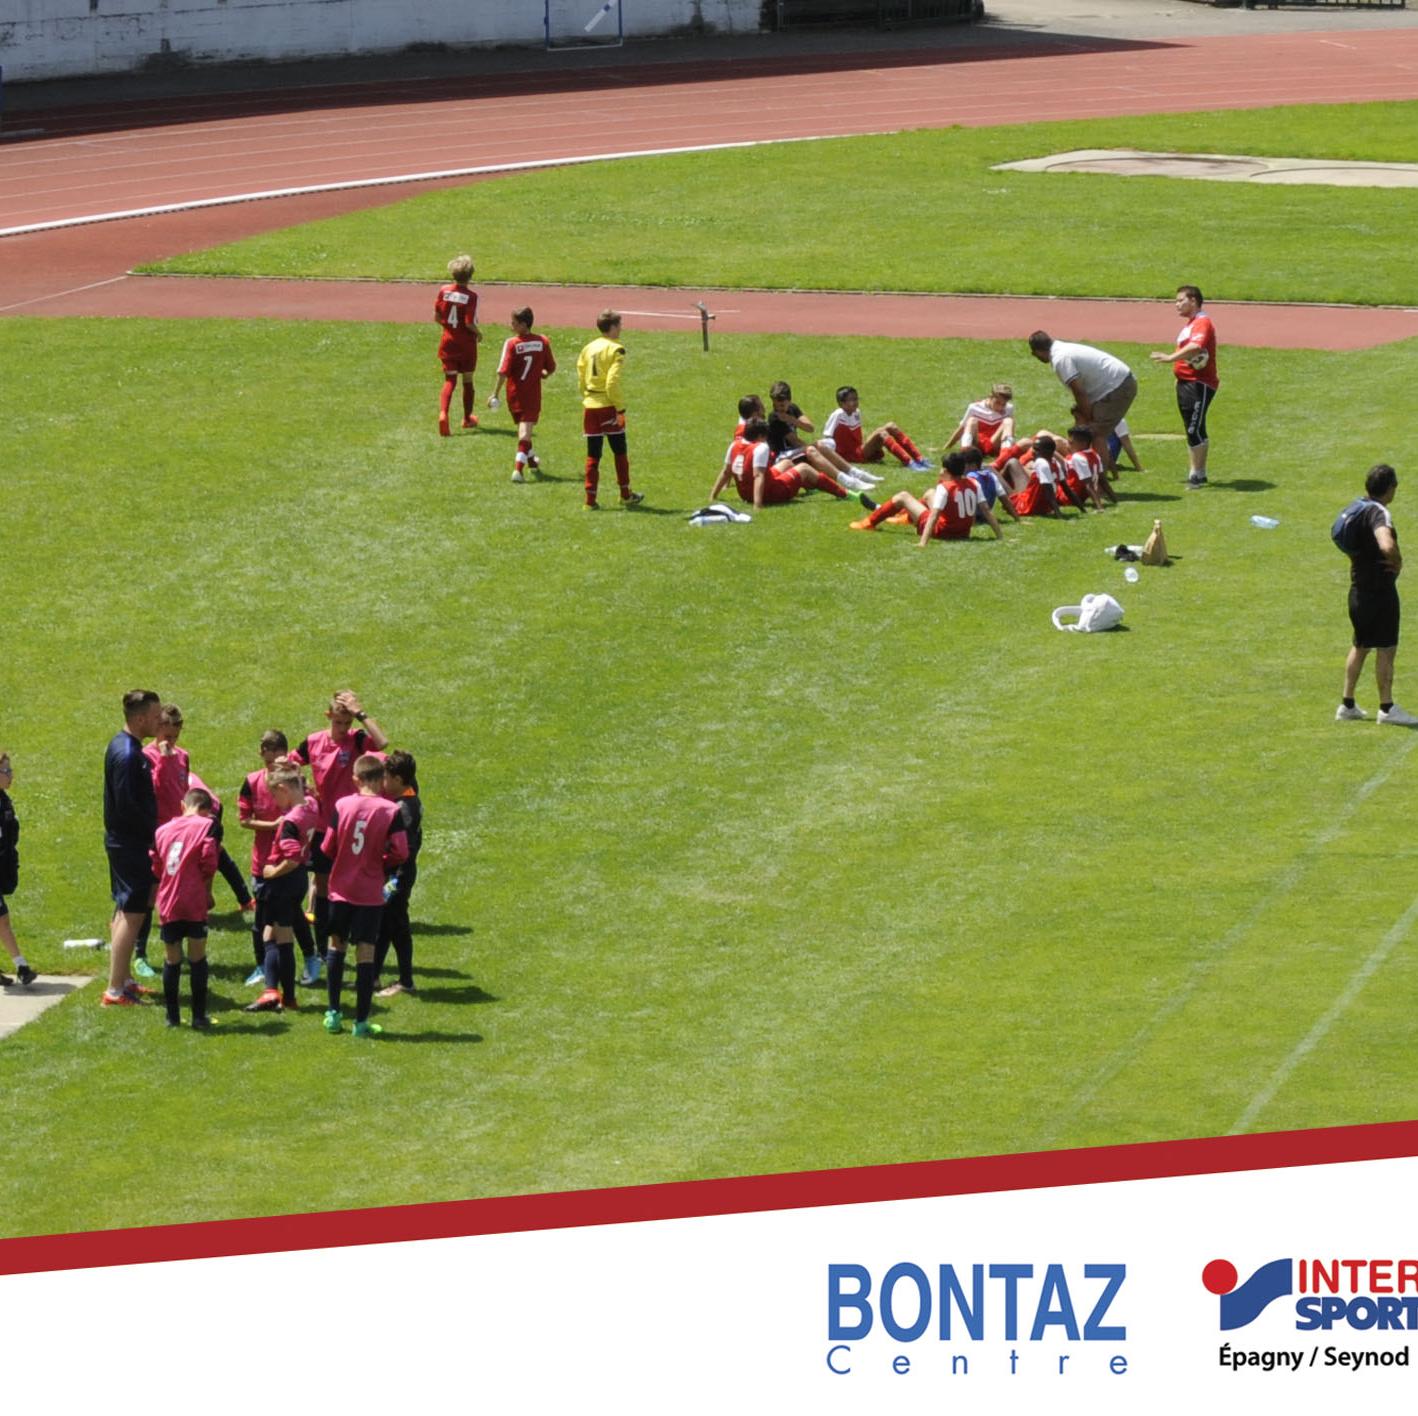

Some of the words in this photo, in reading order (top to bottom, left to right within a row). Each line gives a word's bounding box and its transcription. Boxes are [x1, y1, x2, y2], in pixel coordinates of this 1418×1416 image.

[447, 305, 459, 328] 4
[521, 355, 533, 381] 7
[955, 488, 977, 518] 10
[351, 820, 367, 855] 5
